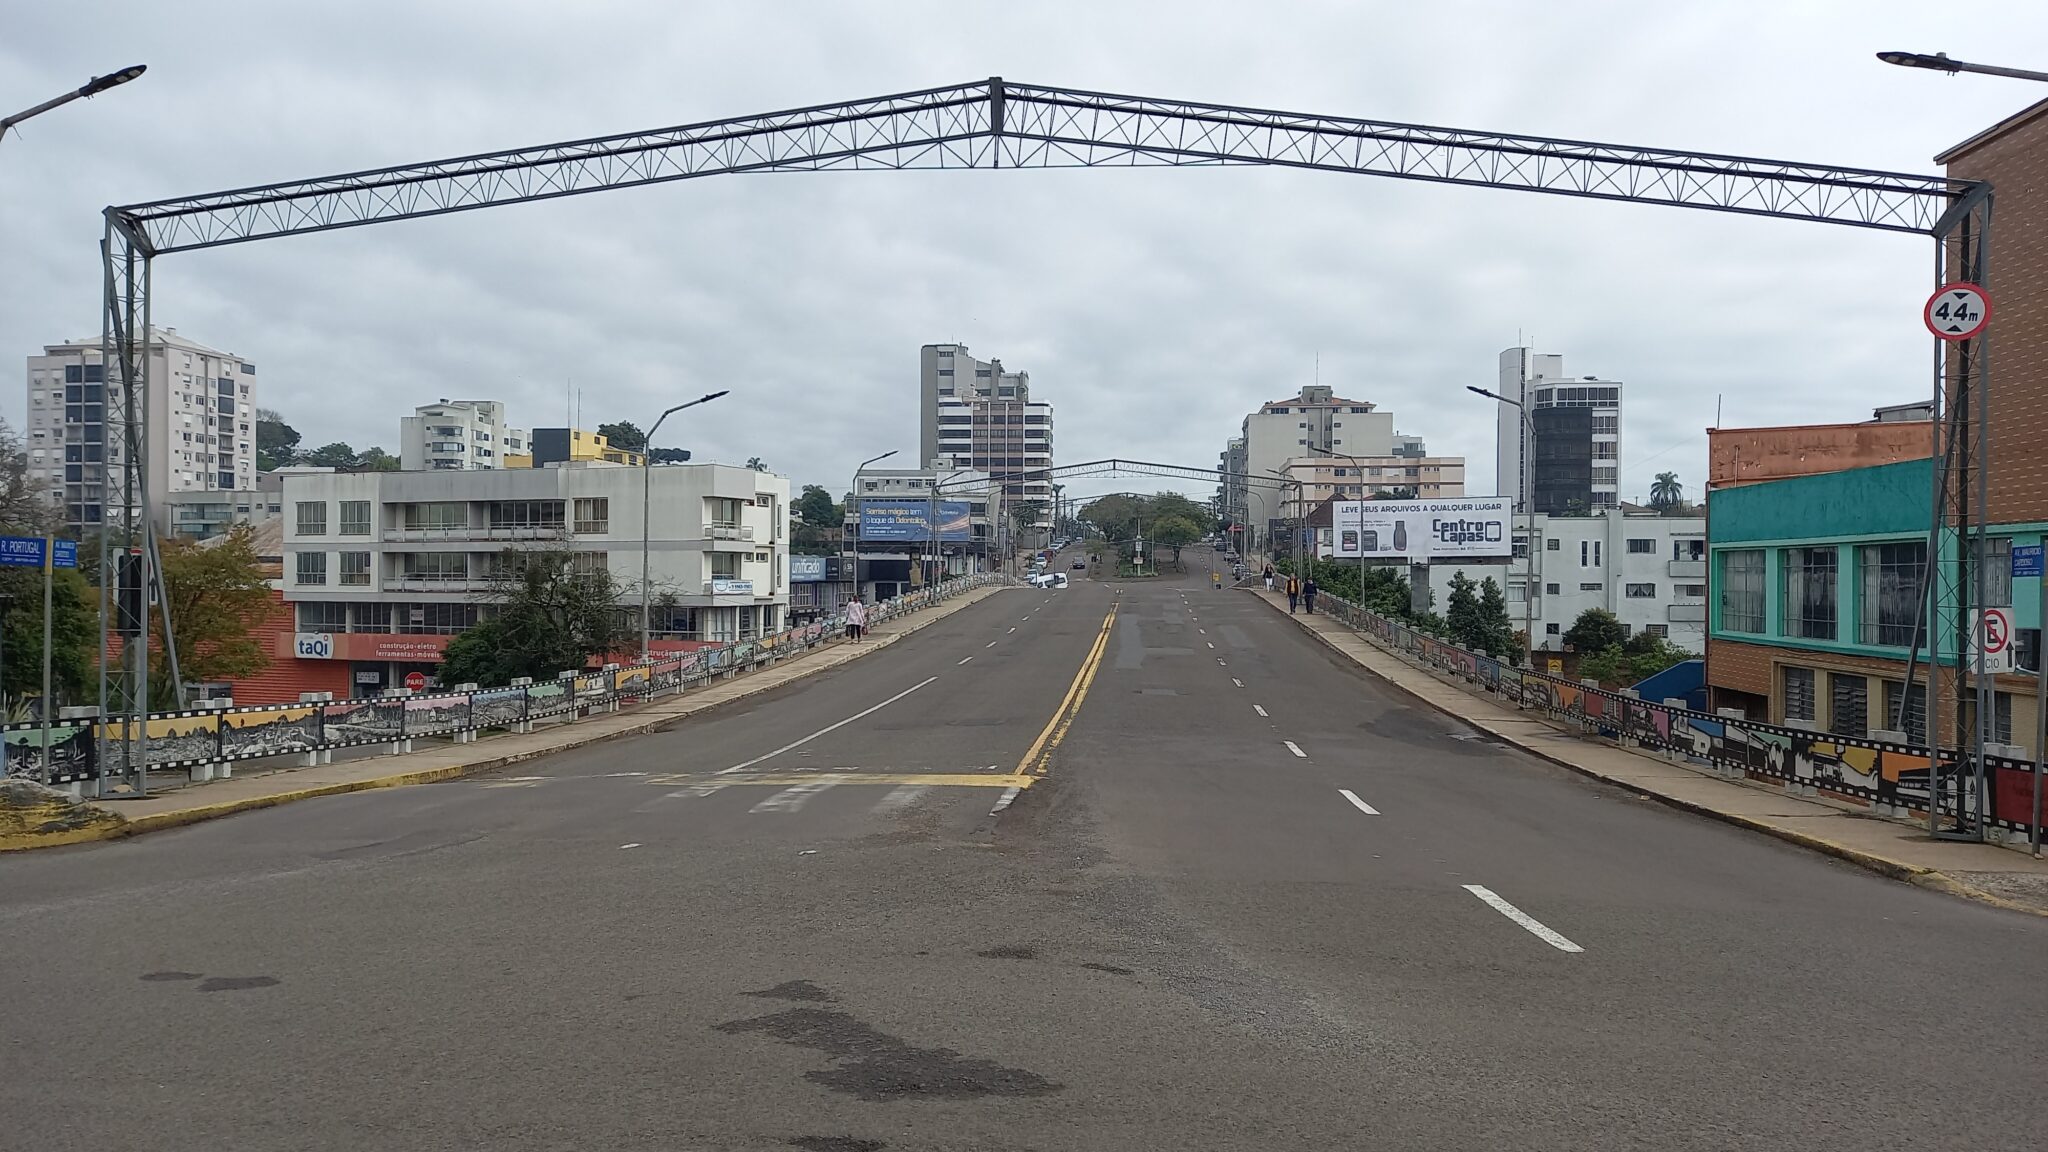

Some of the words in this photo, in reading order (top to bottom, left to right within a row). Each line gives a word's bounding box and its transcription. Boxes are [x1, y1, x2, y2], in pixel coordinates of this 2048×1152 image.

[1380, 505, 1421, 513] ARQUIVOS
[1430, 504, 1473, 512] QUALQUER
[1474, 503, 1502, 511] LUGAR
[870, 517, 887, 525] toque
[1432, 518, 1484, 532] Centro
[1440, 531, 1484, 545] Capas
[9, 540, 40, 554] PORTUGAL
[791, 558, 820, 574] unificado
[299, 634, 329, 657] taQi
